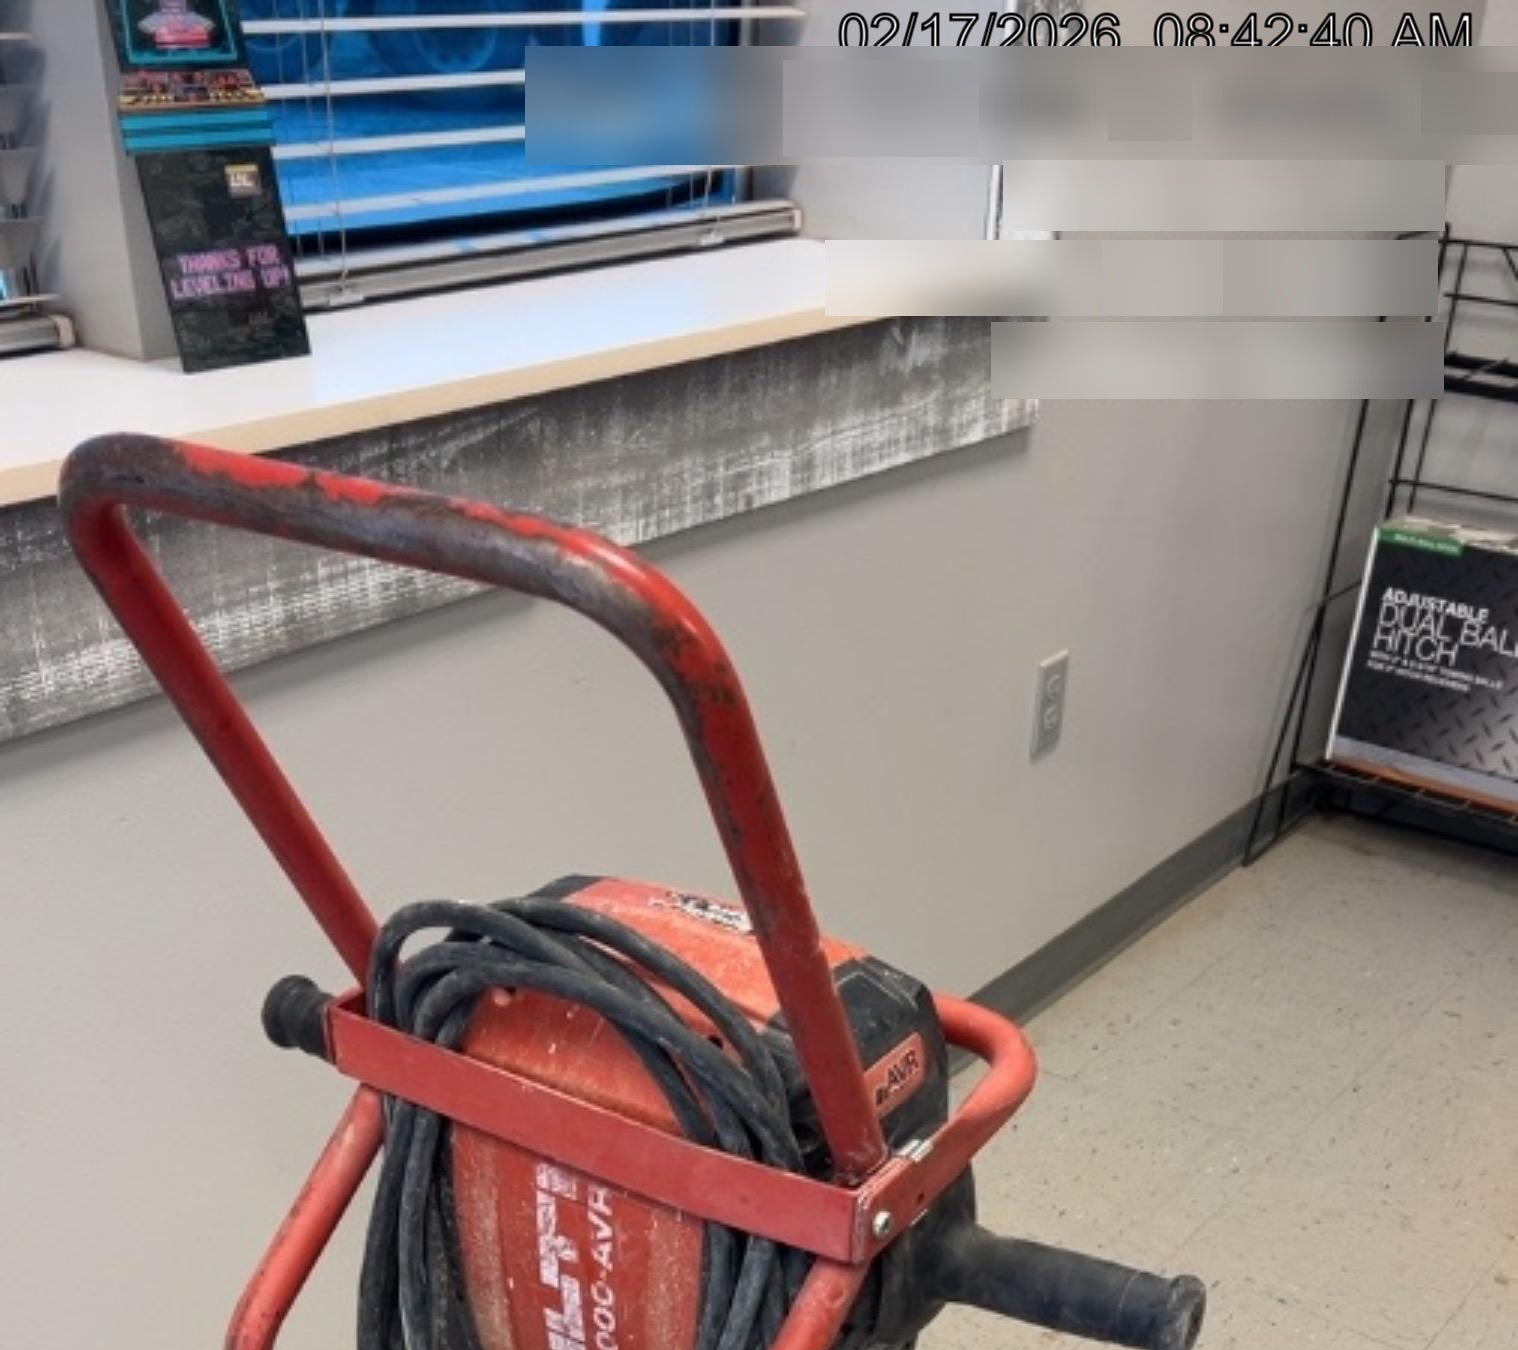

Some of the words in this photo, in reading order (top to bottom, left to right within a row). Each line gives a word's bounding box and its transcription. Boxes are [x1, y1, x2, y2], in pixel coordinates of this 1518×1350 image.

[176, 248, 241, 274] THANKS
[246, 244, 280, 266] FOR
[170, 269, 256, 300] LEVELING
[261, 265, 291, 289] UP!
[1379, 602, 1451, 642] DUAL
[1382, 587, 1490, 625] ADJUSTABLE
[1372, 624, 1460, 667] HITCH
